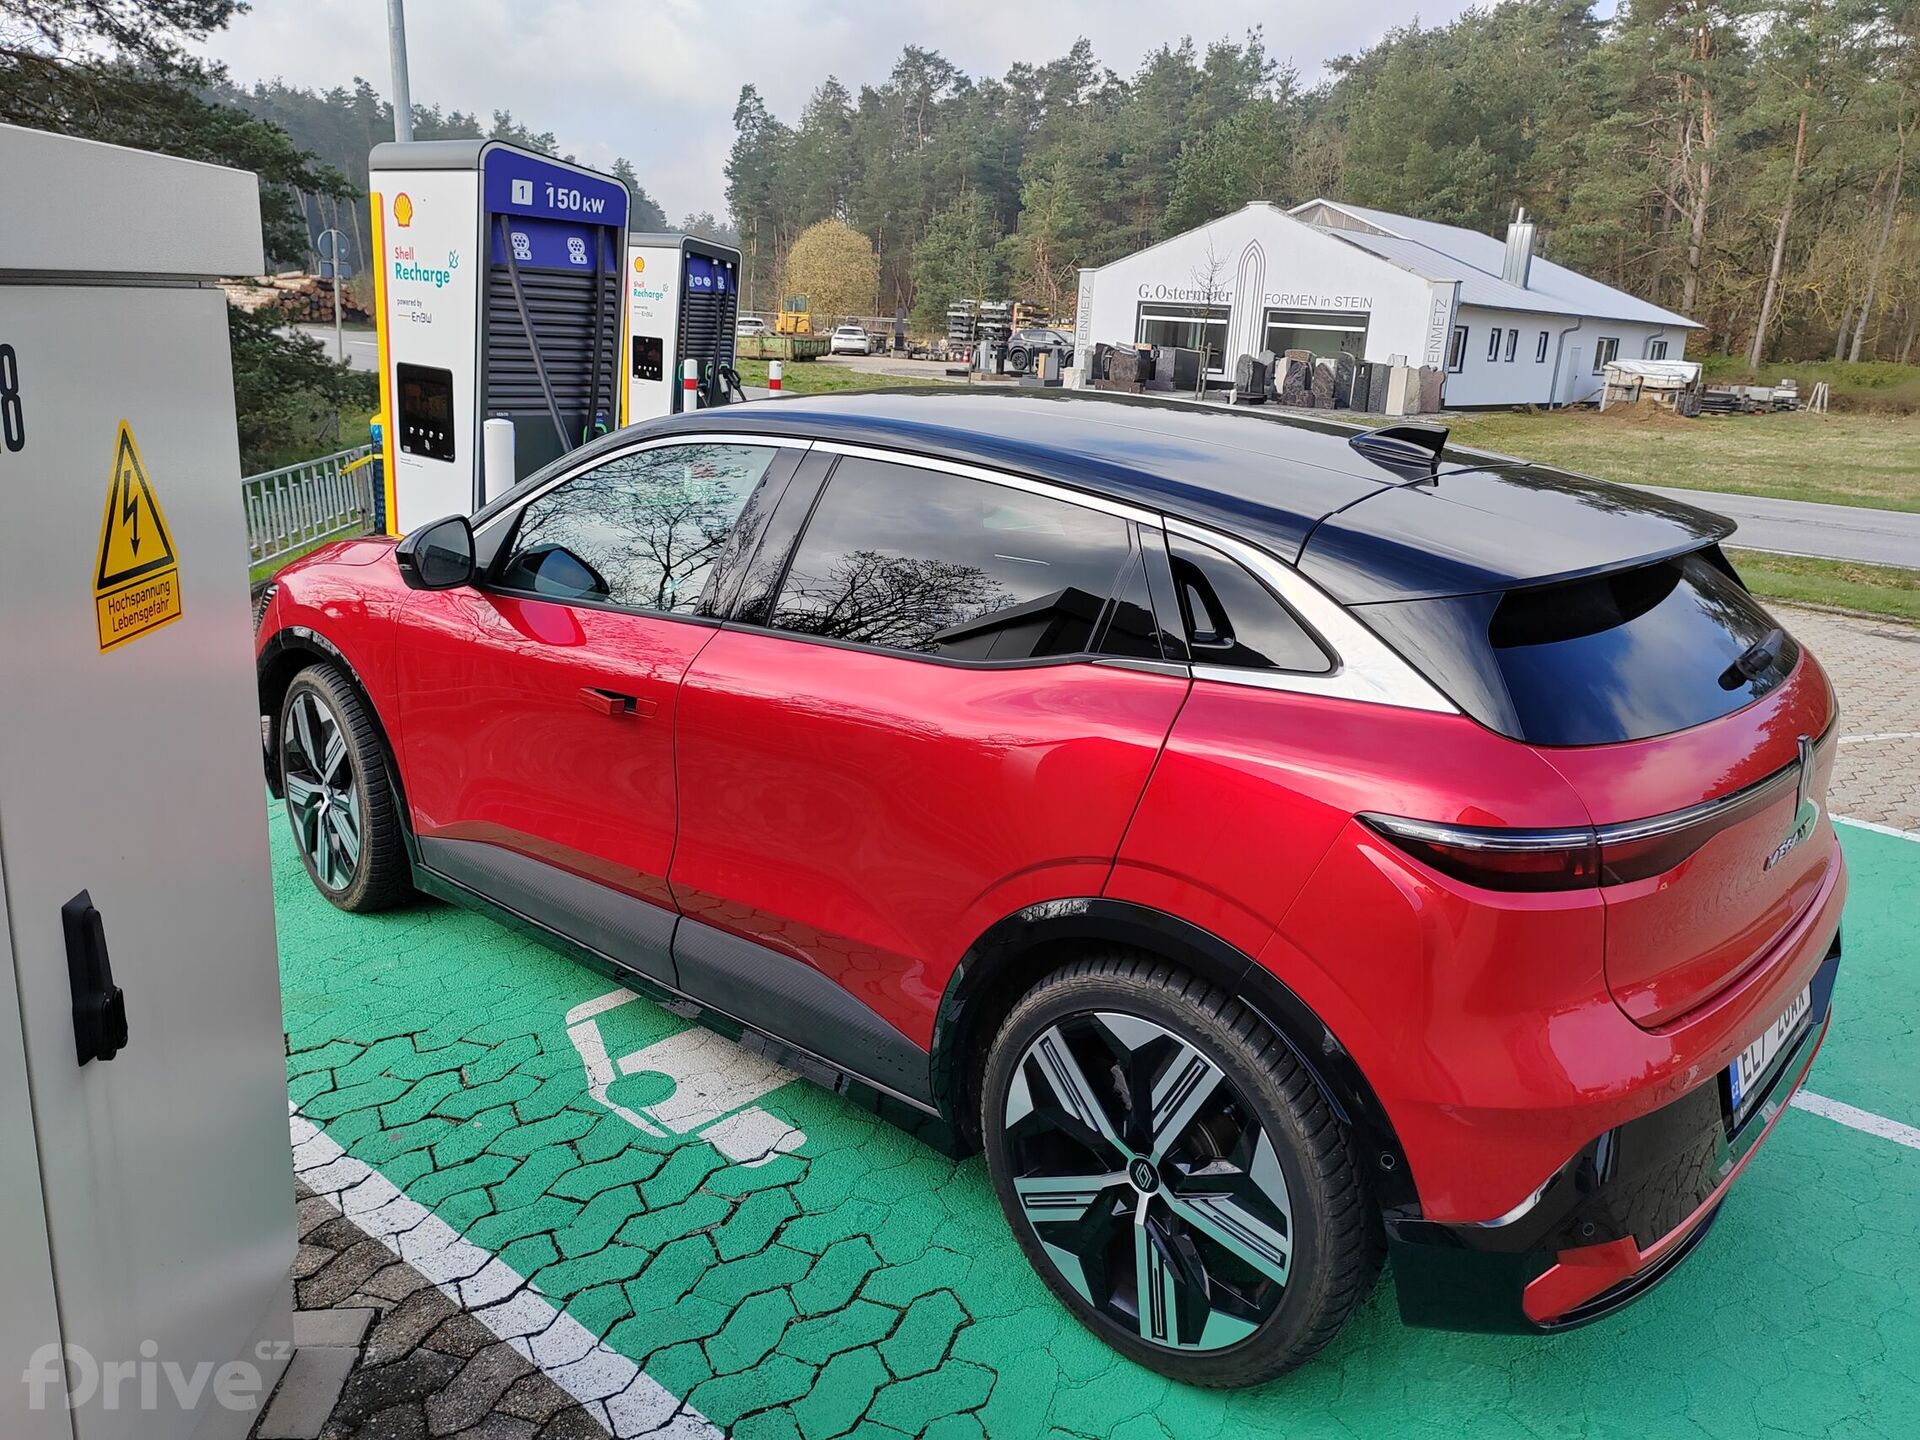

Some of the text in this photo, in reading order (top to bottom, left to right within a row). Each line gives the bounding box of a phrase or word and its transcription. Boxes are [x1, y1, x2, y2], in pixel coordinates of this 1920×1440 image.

[519, 185, 605, 214] 1 150 kW
[394, 246, 414, 260] Shell
[394, 261, 450, 288] Recharge
[396, 298, 416, 307] powered
[633, 288, 664, 301] Recharge
[1138, 283, 1153, 299] G.
[1263, 293, 1373, 308] FORMEN in STEIN
[1077, 286, 1091, 356] STEINMETZ
[1427, 298, 1448, 363] EINMETZ
[107, 580, 171, 615] Hochspannung
[112, 598, 170, 633] Lebensgefahr
